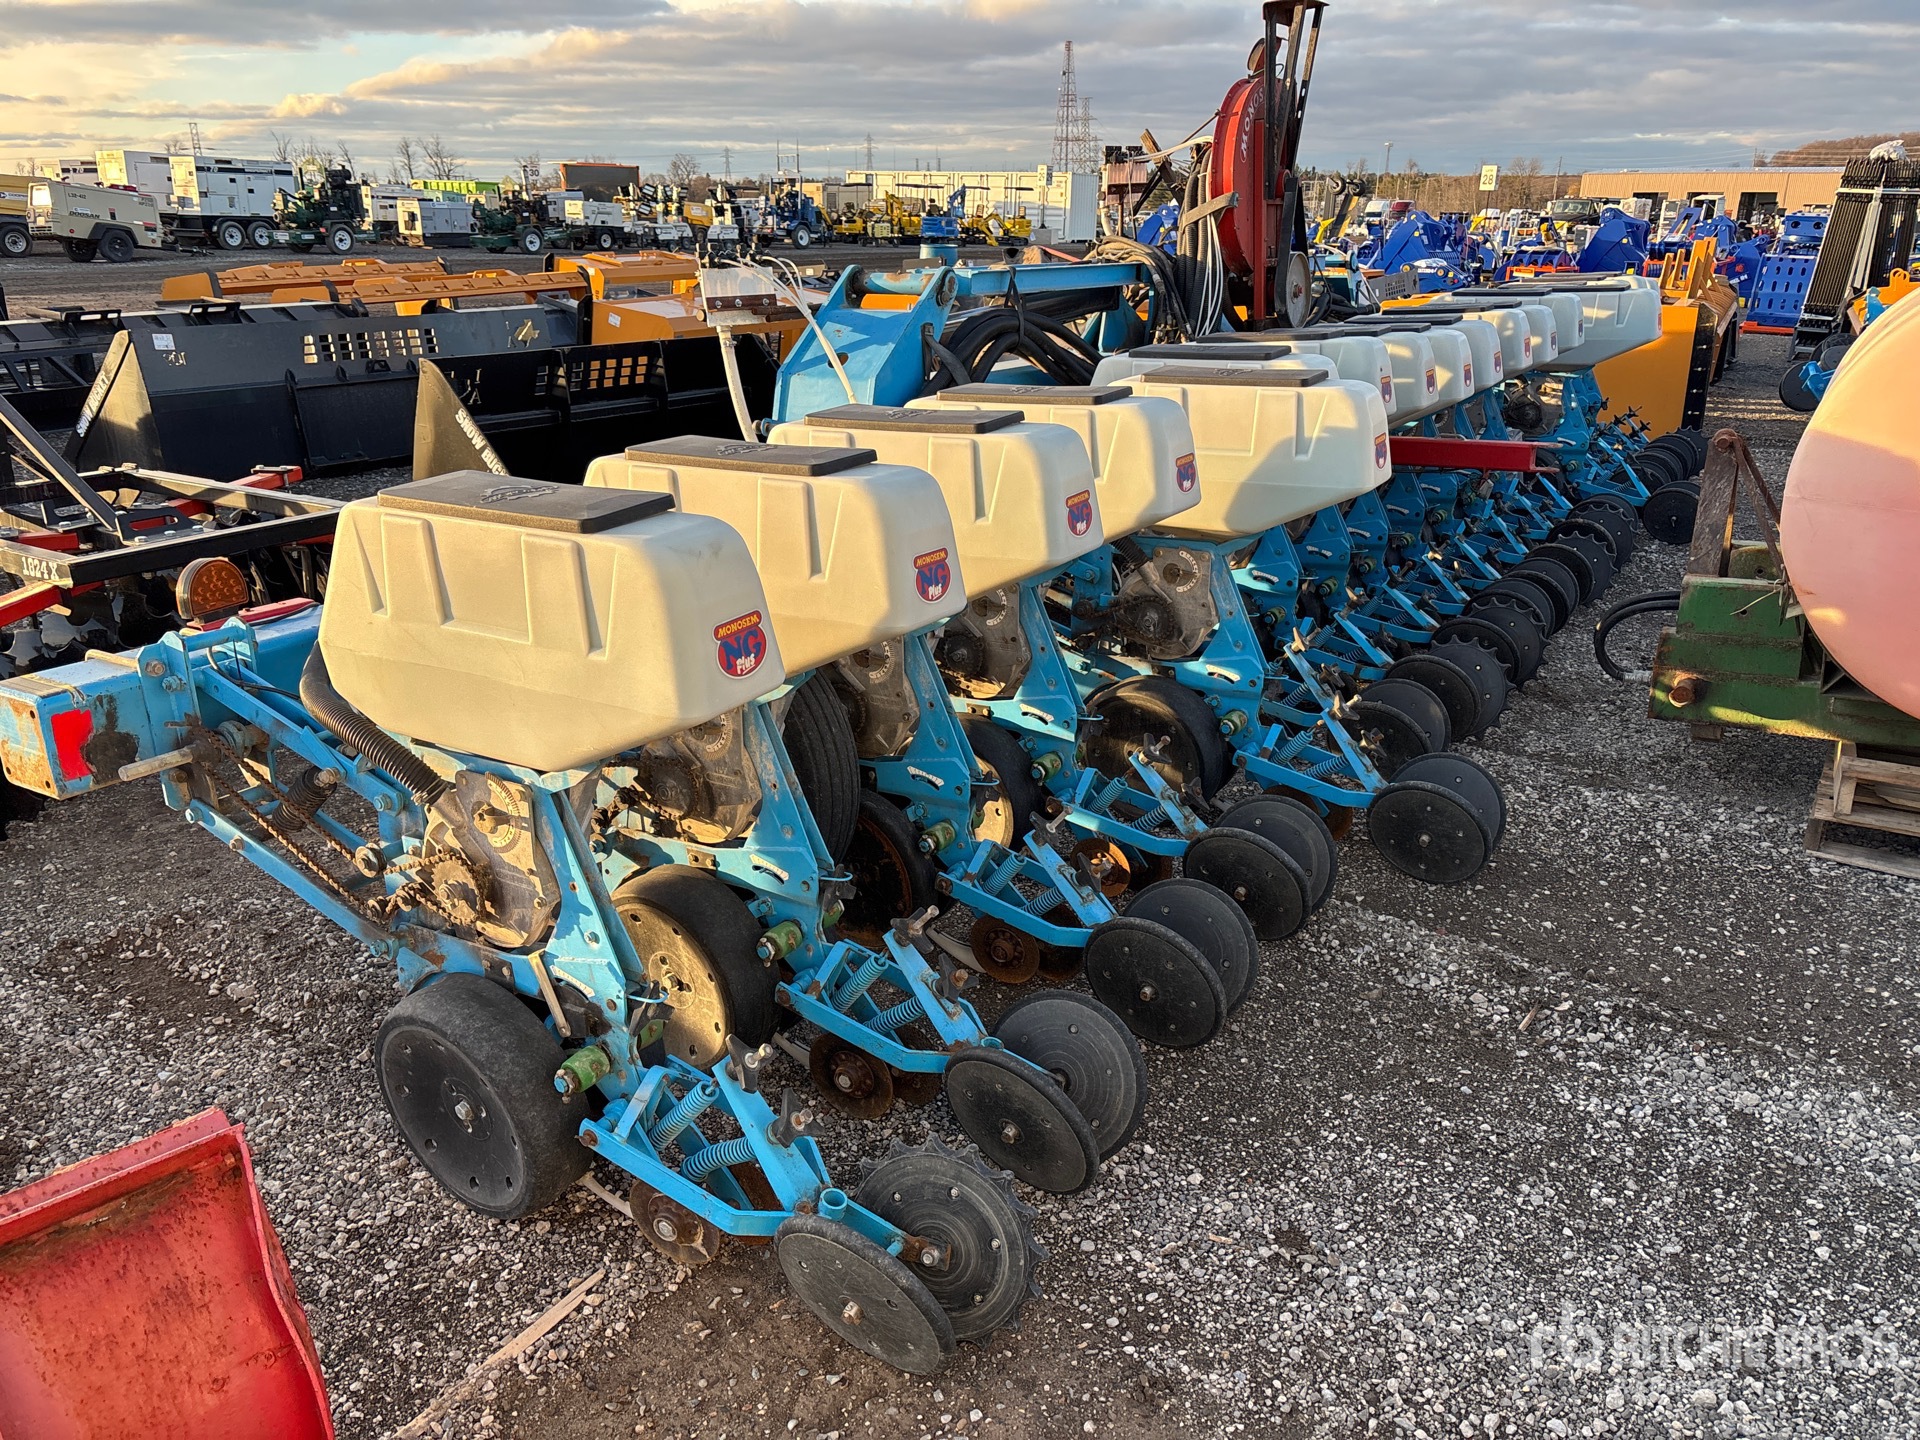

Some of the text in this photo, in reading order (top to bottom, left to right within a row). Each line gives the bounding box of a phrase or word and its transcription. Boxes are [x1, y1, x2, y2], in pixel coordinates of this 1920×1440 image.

[1241, 87, 1265, 158] MONOS
[529, 169, 540, 177] 30
[1482, 174, 1494, 185] 28
[69, 210, 100, 219] DOOSAN
[455, 408, 511, 476] SNOW BUC
[916, 551, 947, 567] MONOSEM
[919, 563, 948, 594] NG
[716, 614, 760, 638] MONOSEM
[721, 629, 762, 671] NG
